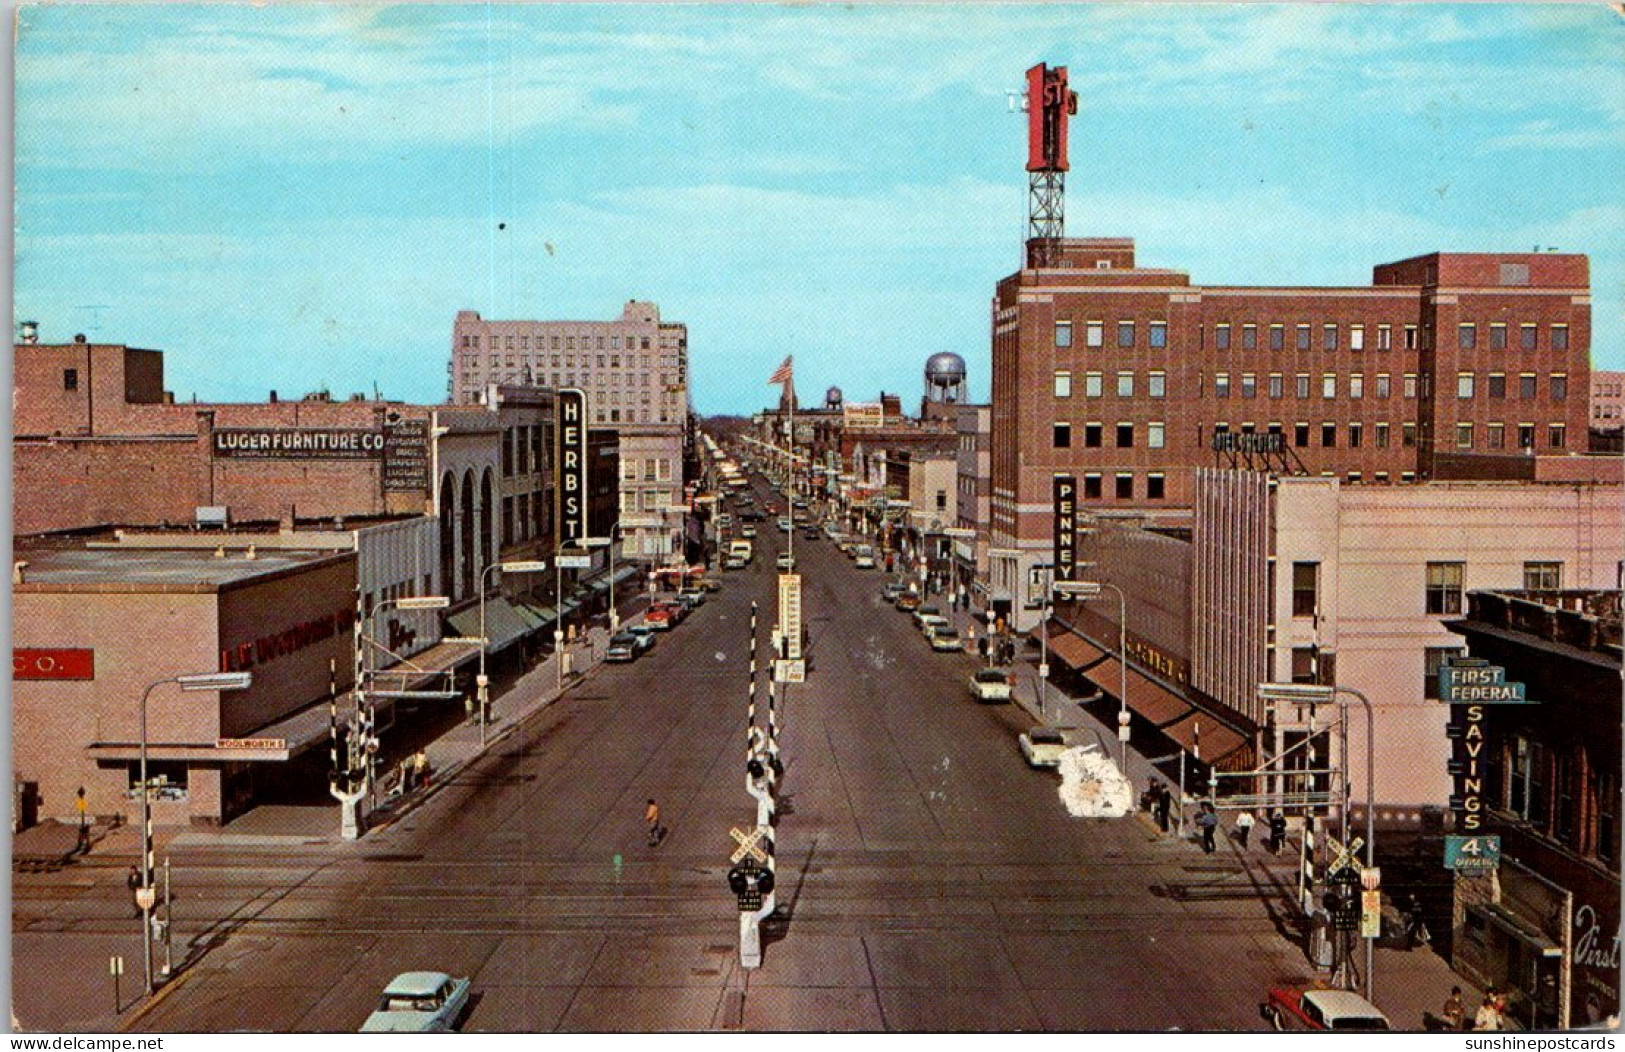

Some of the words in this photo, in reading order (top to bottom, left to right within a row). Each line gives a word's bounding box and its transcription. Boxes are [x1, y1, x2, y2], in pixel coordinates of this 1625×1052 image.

[217, 433, 271, 449] LUGER
[273, 433, 359, 449] FURNITURE
[361, 433, 384, 449] CO
[564, 402, 578, 538] HERBST
[1451, 669, 1502, 684] FIRST
[1451, 686, 1523, 700] FEDERAL
[1464, 706, 1483, 830] SAVINGS
[1461, 838, 1482, 856] 4
